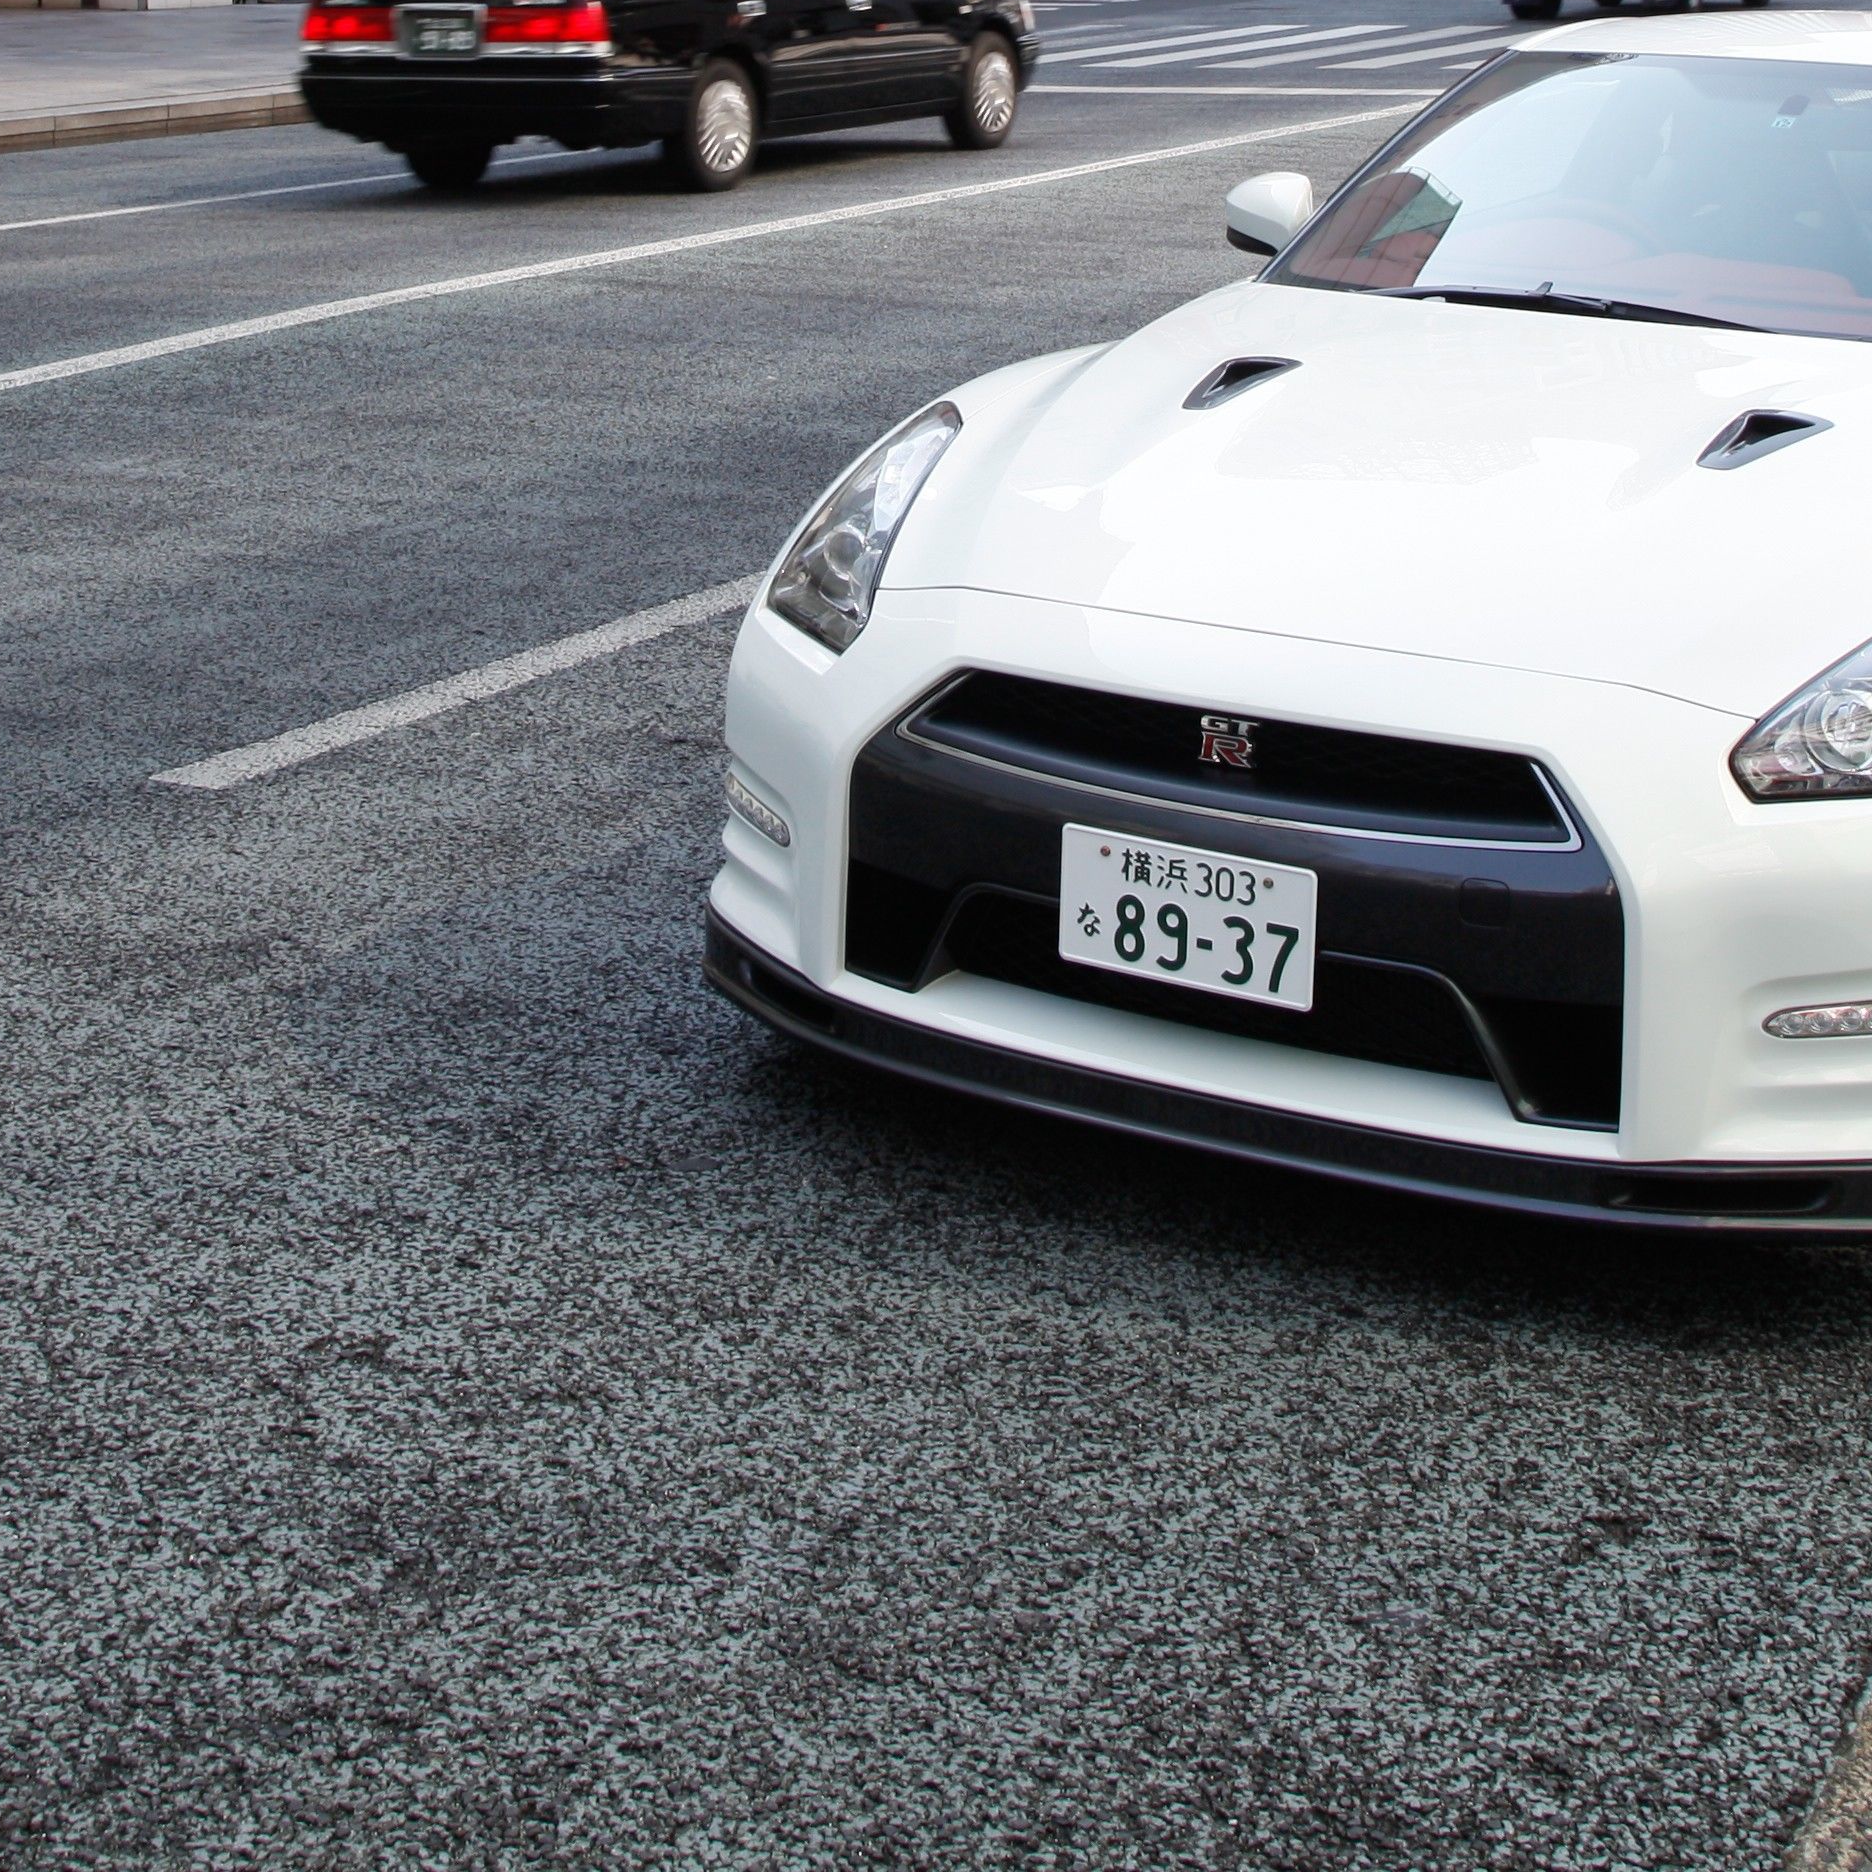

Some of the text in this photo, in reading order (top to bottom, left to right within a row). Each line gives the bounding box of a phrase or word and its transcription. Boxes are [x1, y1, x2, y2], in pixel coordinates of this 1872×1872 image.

[1199, 714, 1260, 736] GT
[1198, 730, 1258, 770] R
[1076, 893, 1300, 994] な 89-37
